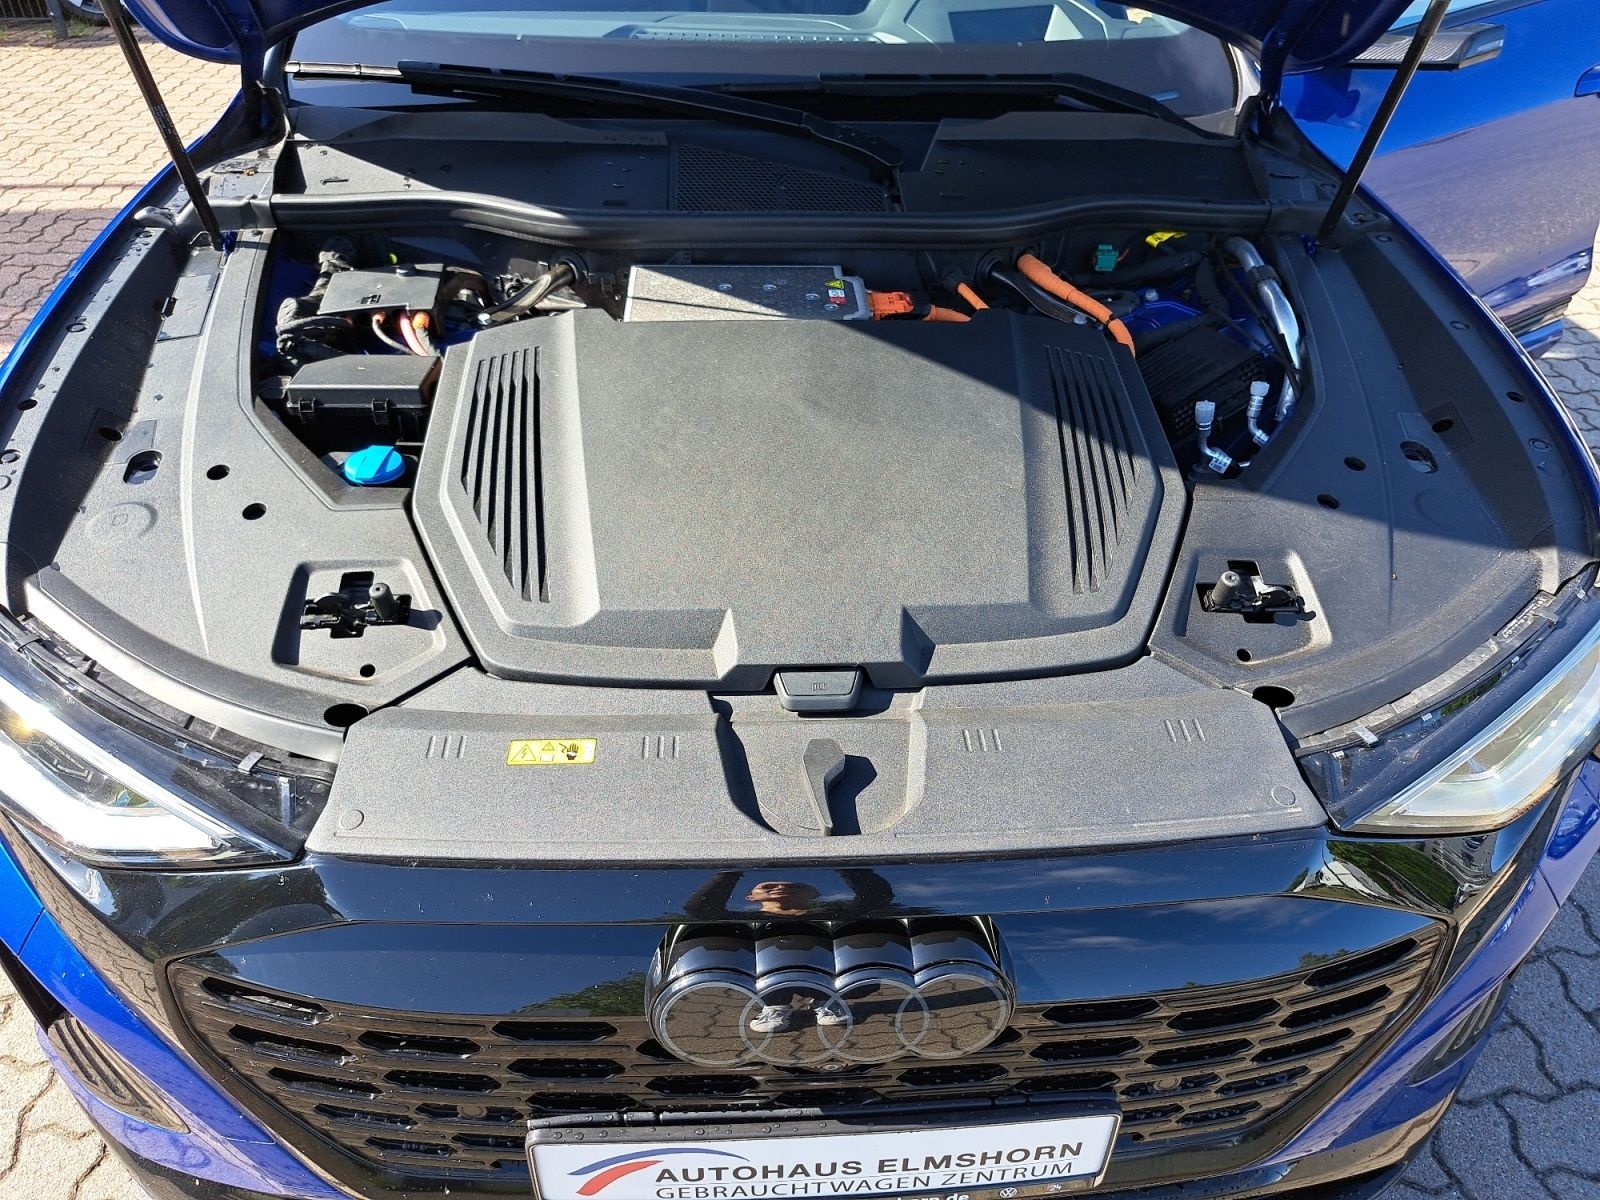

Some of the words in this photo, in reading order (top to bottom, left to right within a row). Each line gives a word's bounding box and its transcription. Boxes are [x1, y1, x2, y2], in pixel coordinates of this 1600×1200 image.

[655, 1160, 863, 1183] AUTOHAUS
[877, 1141, 1083, 1174] ELMSHORN
[655, 1175, 930, 1199] GEBRAUCHTWAGEN
[940, 1162, 1072, 1187] ZENTRUM
